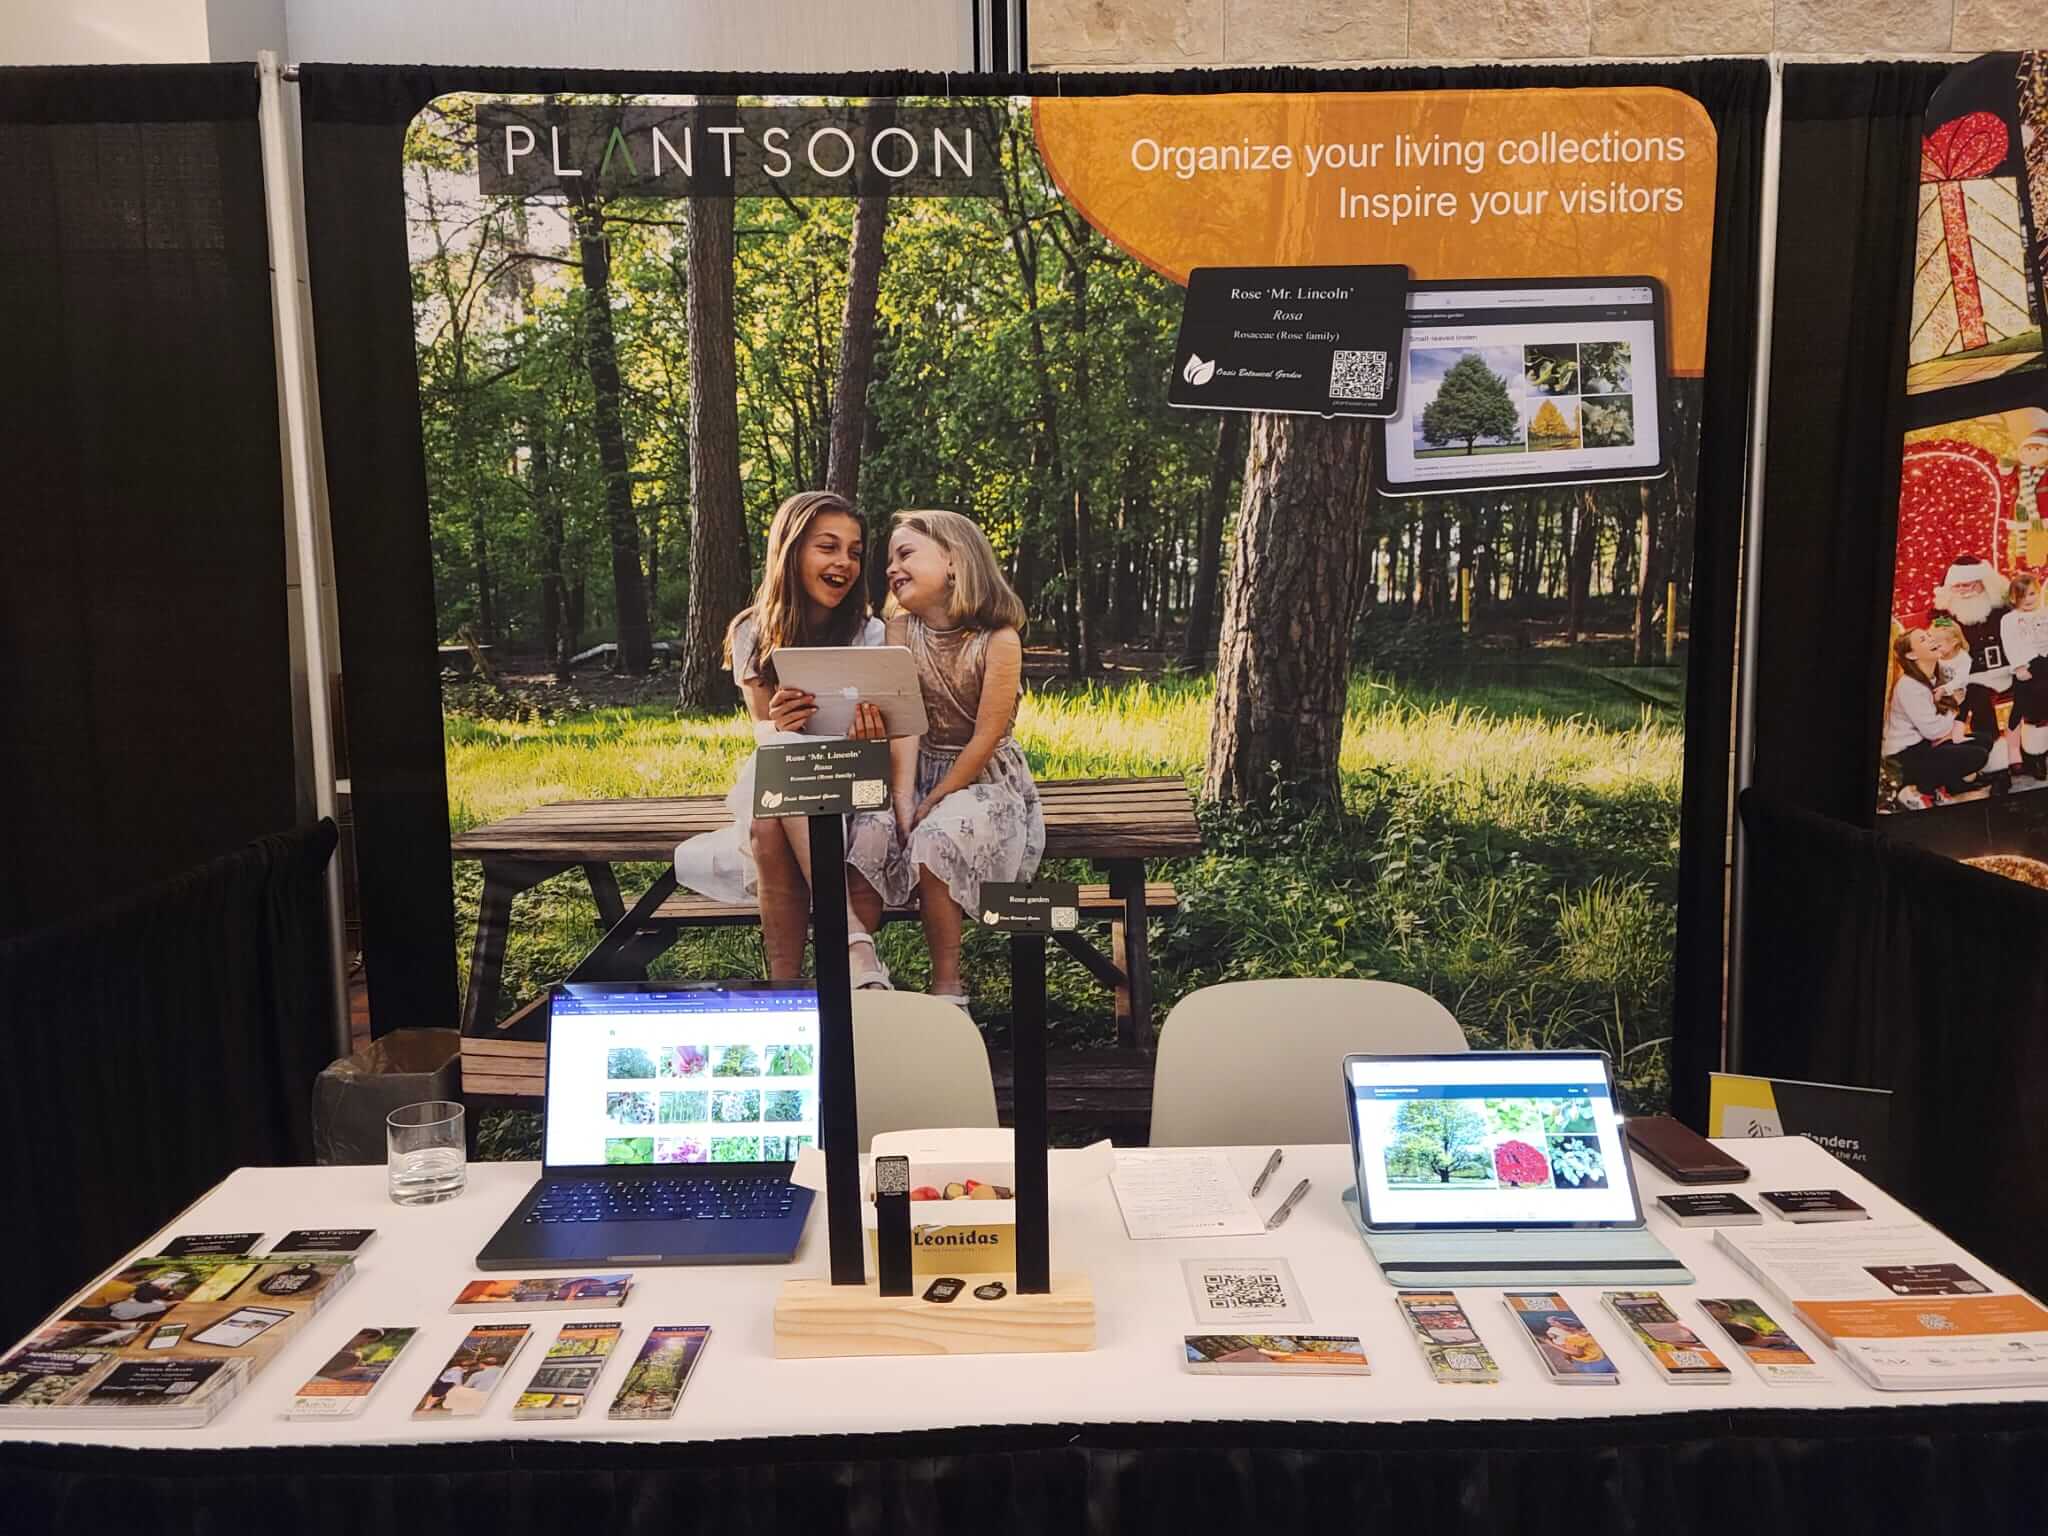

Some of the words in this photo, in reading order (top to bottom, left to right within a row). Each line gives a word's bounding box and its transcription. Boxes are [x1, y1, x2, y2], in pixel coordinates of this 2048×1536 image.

[503, 124, 975, 179] PLANTSOON
[1130, 137, 1293, 179] Organize
[1304, 142, 1383, 177] your
[1394, 133, 1486, 173] living
[1496, 130, 1686, 165] collections
[1338, 185, 1457, 225] Inspire
[1469, 187, 1547, 223] your
[1558, 182, 1685, 215] visitors
[1230, 288, 1262, 300] Rose
[1272, 309, 1304, 321] Rosa
[1305, 330, 1340, 342] family)
[914, 1230, 999, 1246] Leonidas
